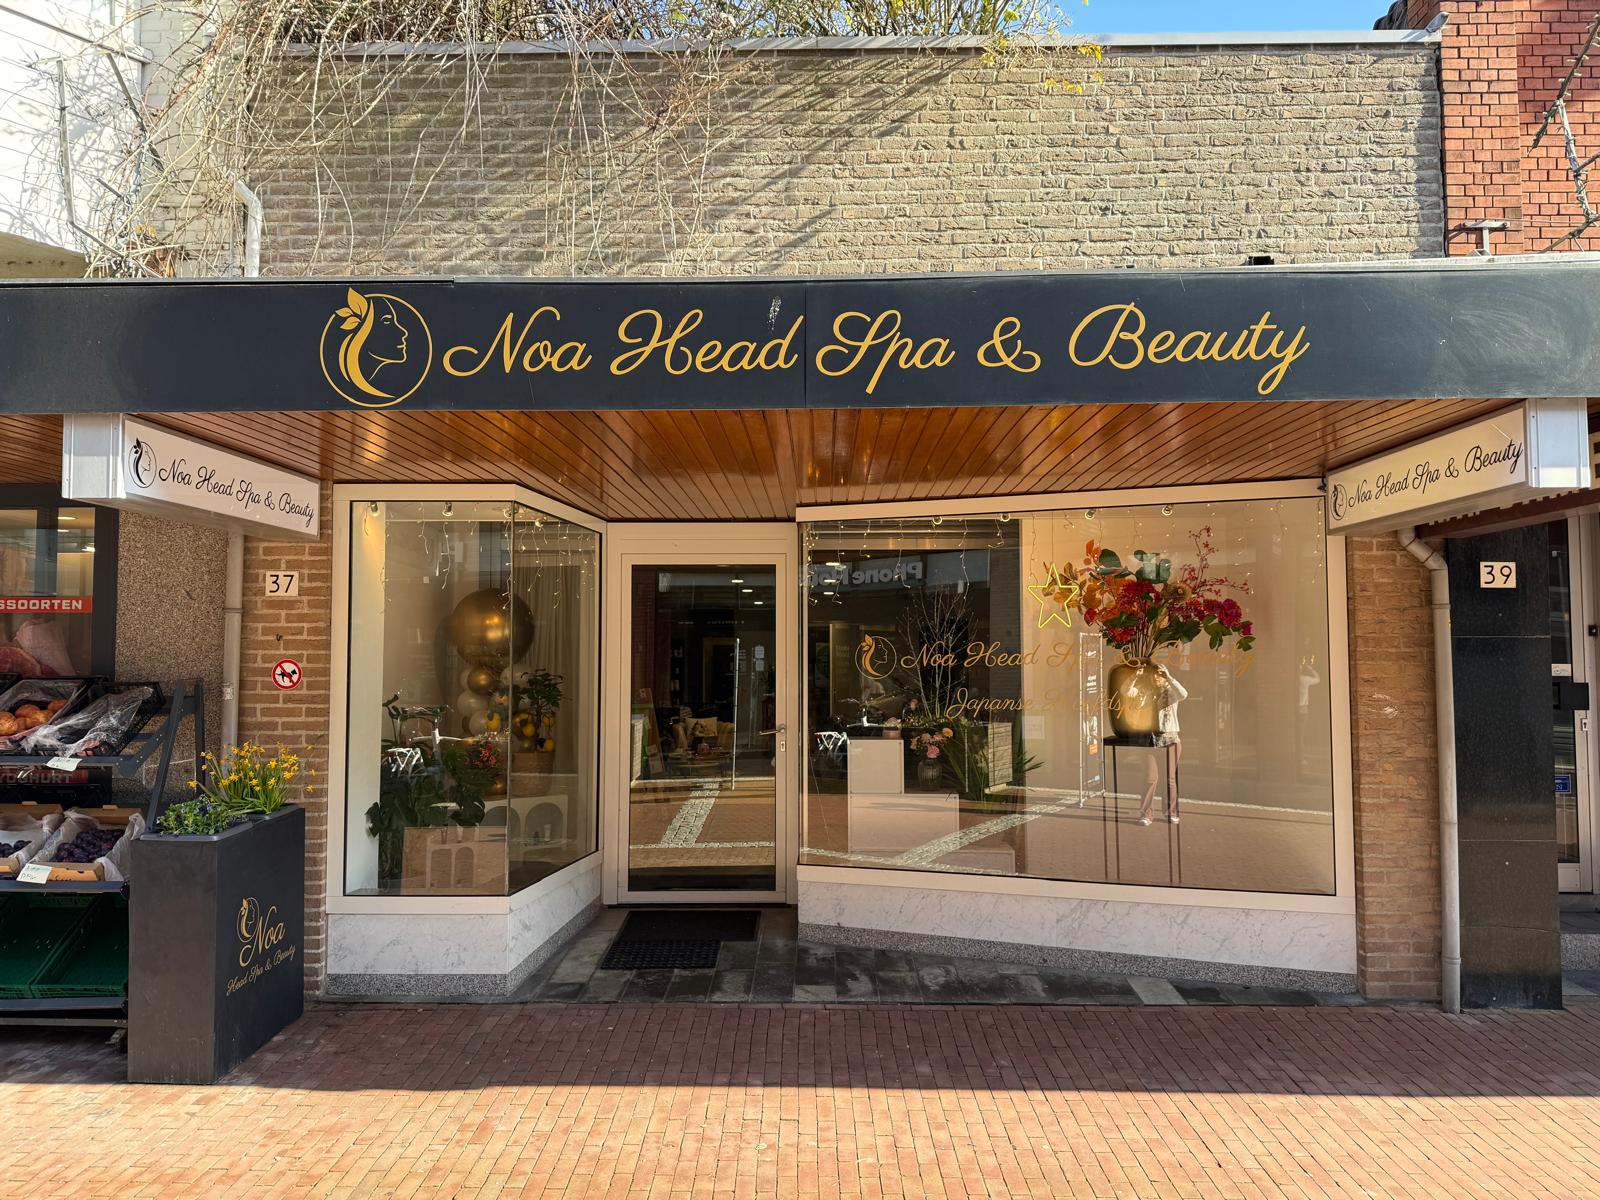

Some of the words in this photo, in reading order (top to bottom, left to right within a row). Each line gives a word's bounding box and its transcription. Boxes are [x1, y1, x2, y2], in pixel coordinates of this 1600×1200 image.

[442, 306, 592, 377] Noa
[610, 308, 804, 375] Head
[815, 309, 956, 395] Spa
[976, 316, 1042, 373] &
[1068, 301, 1310, 395] Beauty
[158, 458, 193, 487] Noa
[195, 465, 233, 497] Head
[236, 480, 261, 510] Spa
[263, 492, 275, 511] &
[278, 492, 314, 527] Beauty
[1348, 479, 1372, 508] Noa
[1375, 466, 1410, 500] Head
[1412, 461, 1441, 494] Spa
[1444, 457, 1460, 479] &
[1464, 438, 1524, 474] Beauty
[268, 574, 295, 594] 37
[1483, 564, 1513, 585] 39
[900, 640, 958, 669] Noa
[963, 641, 1041, 668] Head
[1114, 644, 1141, 668] &
[1150, 640, 1254, 678] Bety
[945, 687, 1034, 720] Japanse
[240, 905, 285, 967] Noa
[226, 971, 249, 996] Head
[249, 964, 263, 984] Spa
[274, 944, 296, 966] Beauty
